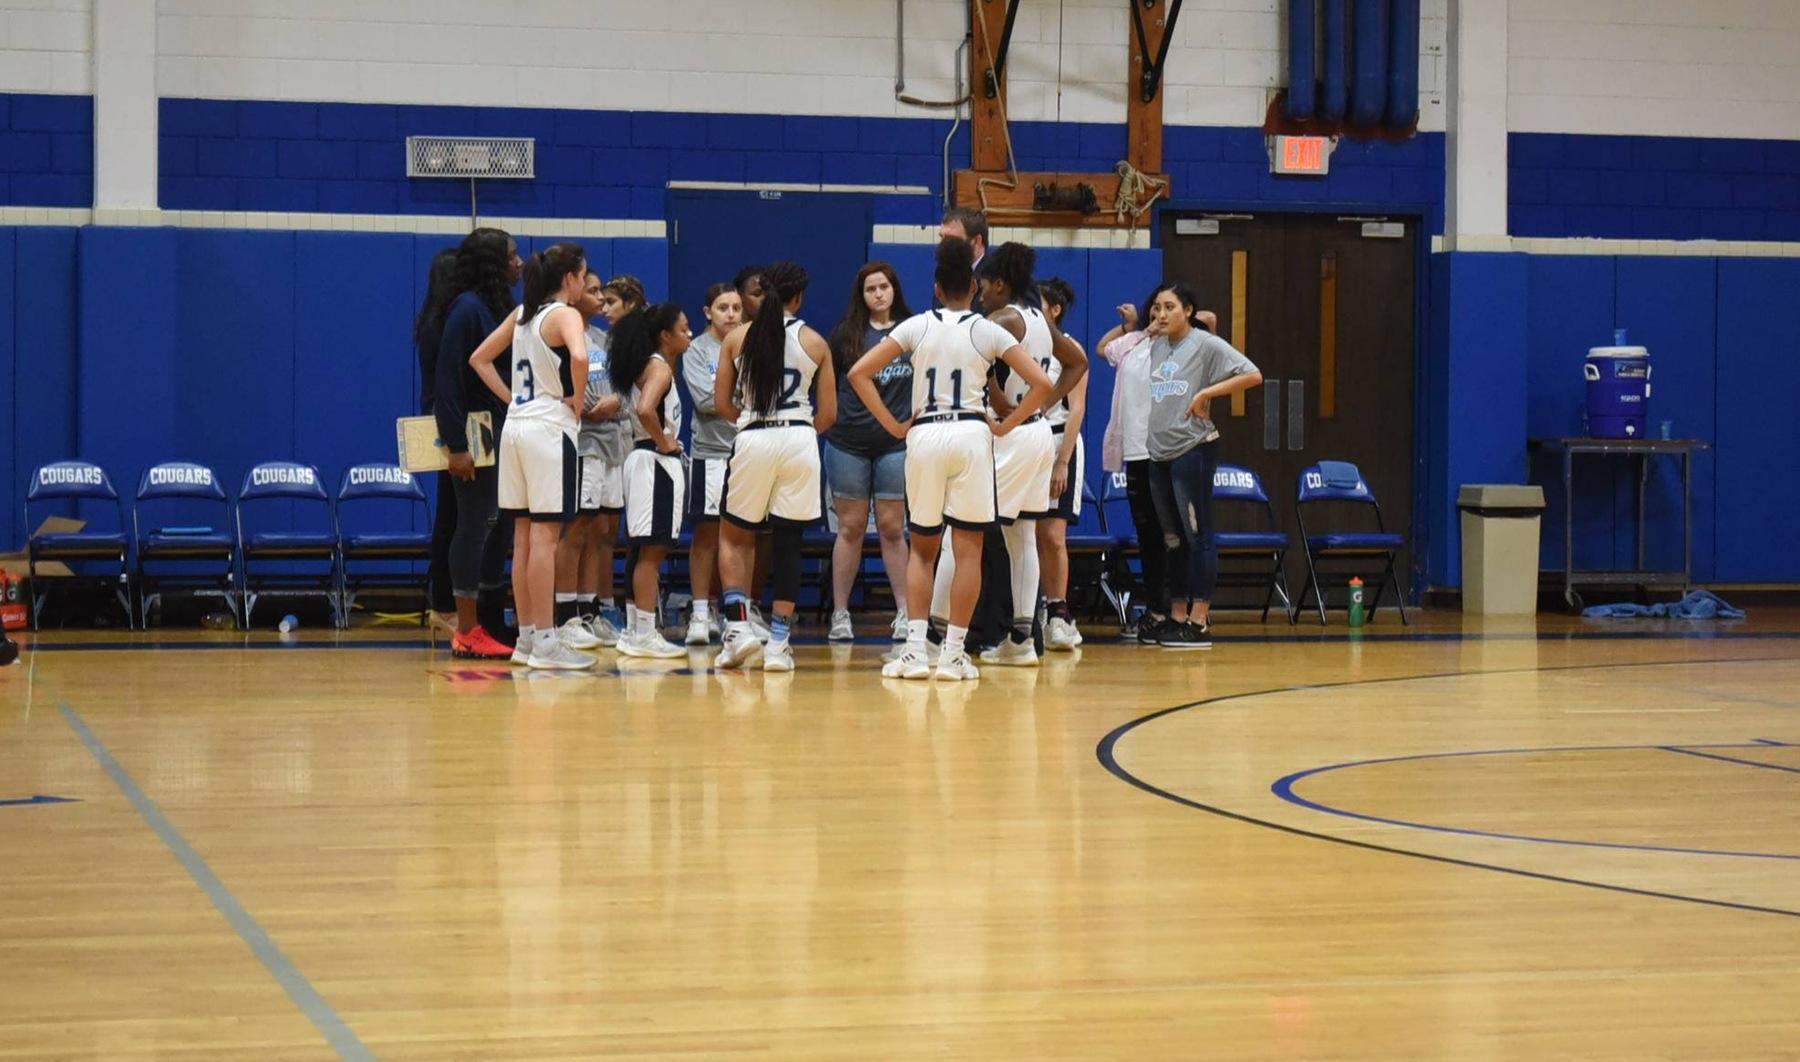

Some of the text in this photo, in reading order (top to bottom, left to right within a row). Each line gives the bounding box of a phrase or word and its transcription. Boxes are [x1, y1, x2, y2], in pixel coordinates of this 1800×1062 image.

[1284, 136, 1324, 169] EXIT
[515, 358, 535, 406] 3
[777, 367, 802, 409] 2
[925, 367, 966, 414] 11
[40, 467, 102, 486] COUGARS
[149, 467, 212, 486] COUGARS
[252, 467, 315, 486] COUGARS
[349, 467, 410, 486] COUGARS
[1213, 471, 1254, 489] UGARS
[1352, 590, 1363, 604] G
